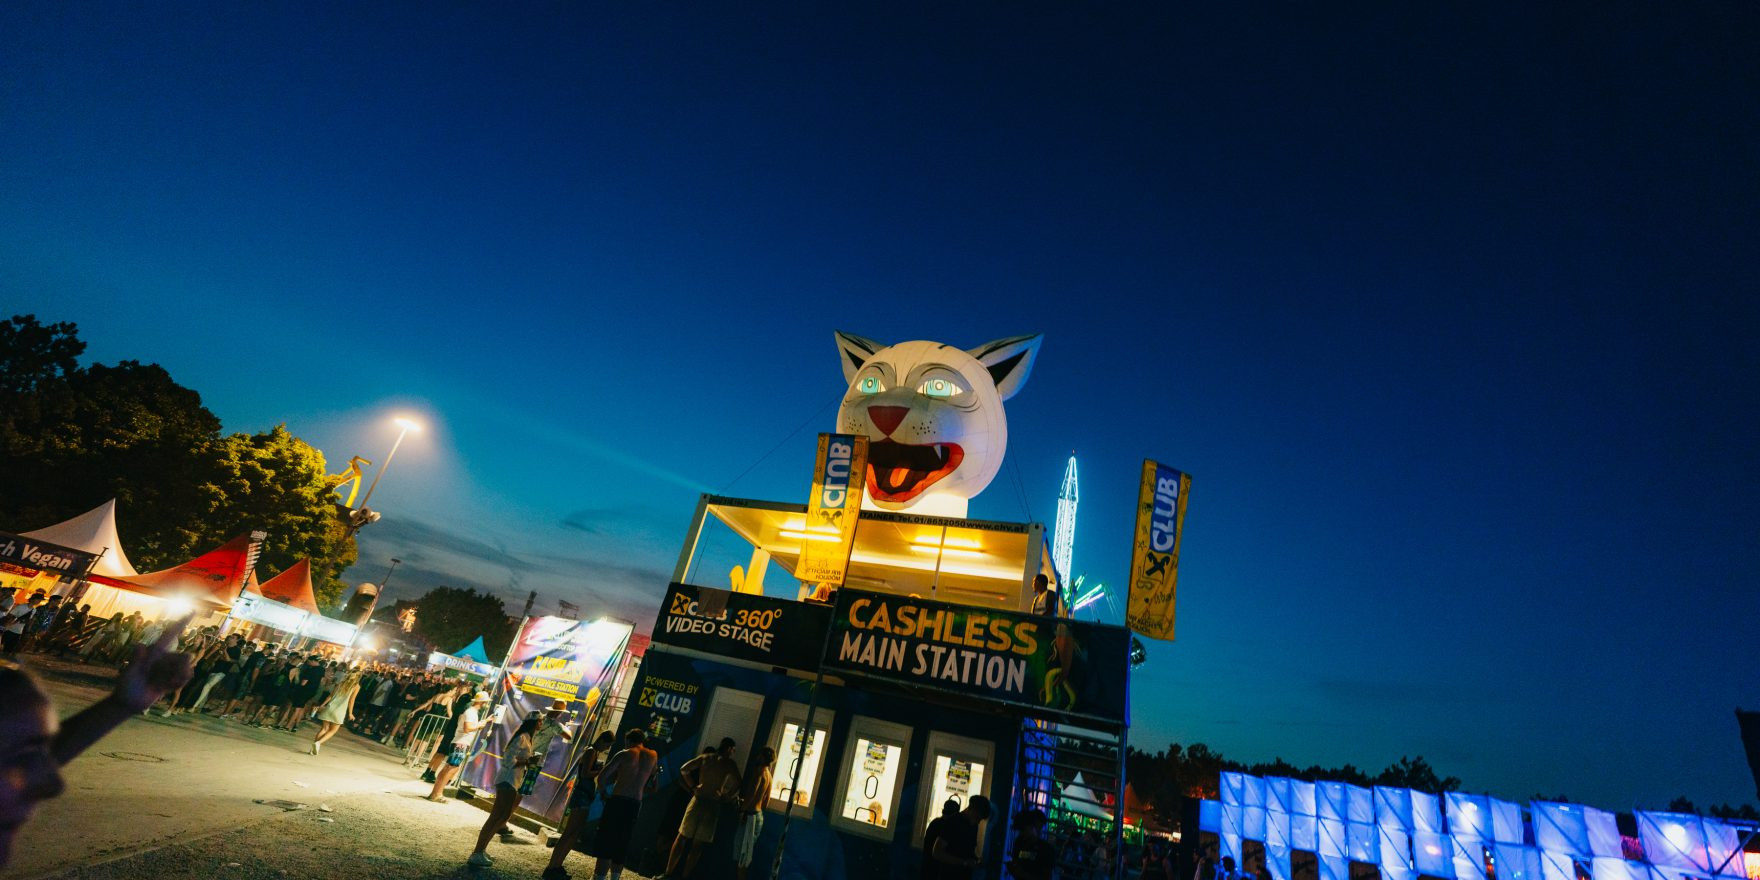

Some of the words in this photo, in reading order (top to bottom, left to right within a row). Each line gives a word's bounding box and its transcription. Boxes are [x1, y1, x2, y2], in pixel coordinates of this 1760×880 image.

[1153, 476, 1178, 551] CLUB
[21, 543, 72, 570] Vegan
[666, 615, 716, 634] VIDEO
[718, 623, 775, 653] STAGE
[849, 597, 1039, 656] CASHLESS
[445, 658, 478, 672] DRINKS
[839, 630, 907, 672] MAIN
[912, 643, 1027, 695] STATION
[555, 682, 580, 694] STATION
[645, 675, 686, 692] POWERED
[686, 684, 699, 695] BY
[654, 692, 692, 714] CLUB
